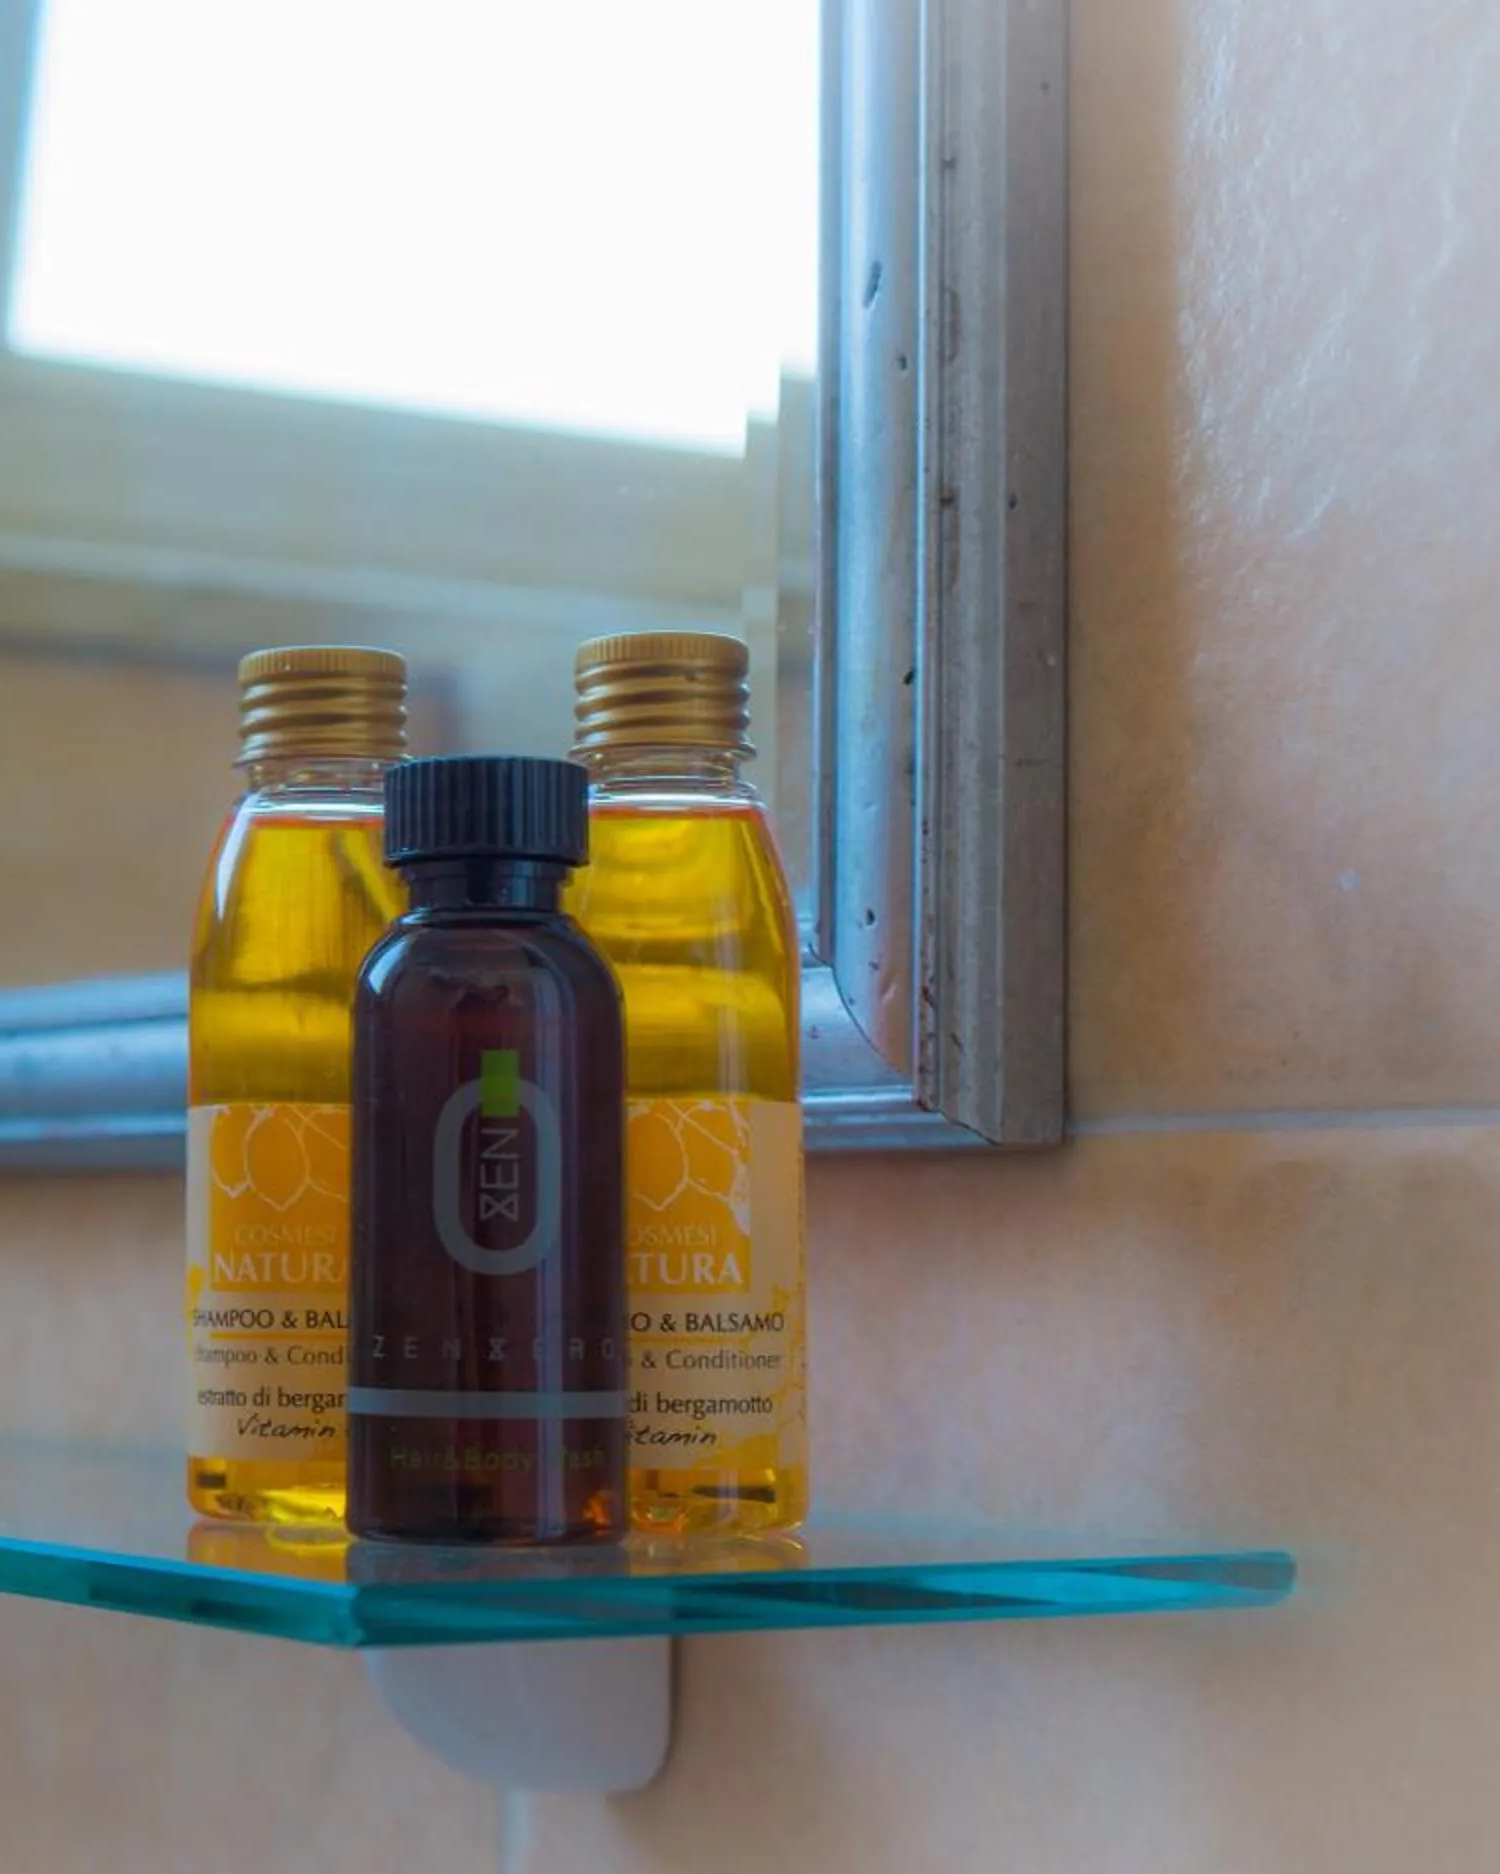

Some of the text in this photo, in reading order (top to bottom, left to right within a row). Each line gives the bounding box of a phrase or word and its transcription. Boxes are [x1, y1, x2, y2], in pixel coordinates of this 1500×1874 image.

[234, 1222, 337, 1247] COSMESI
[629, 1252, 744, 1286] TURA
[281, 1310, 298, 1330] &
[305, 1310, 349, 1330] BAL
[659, 1312, 677, 1332] &
[685, 1312, 785, 1333] BALSAMO
[264, 1346, 278, 1366] &
[287, 1345, 344, 1366] Cond
[641, 1350, 657, 1369] &
[252, 1386, 270, 1407] di
[656, 1391, 774, 1421] bergamotto
[237, 1412, 336, 1439] Vitamin
